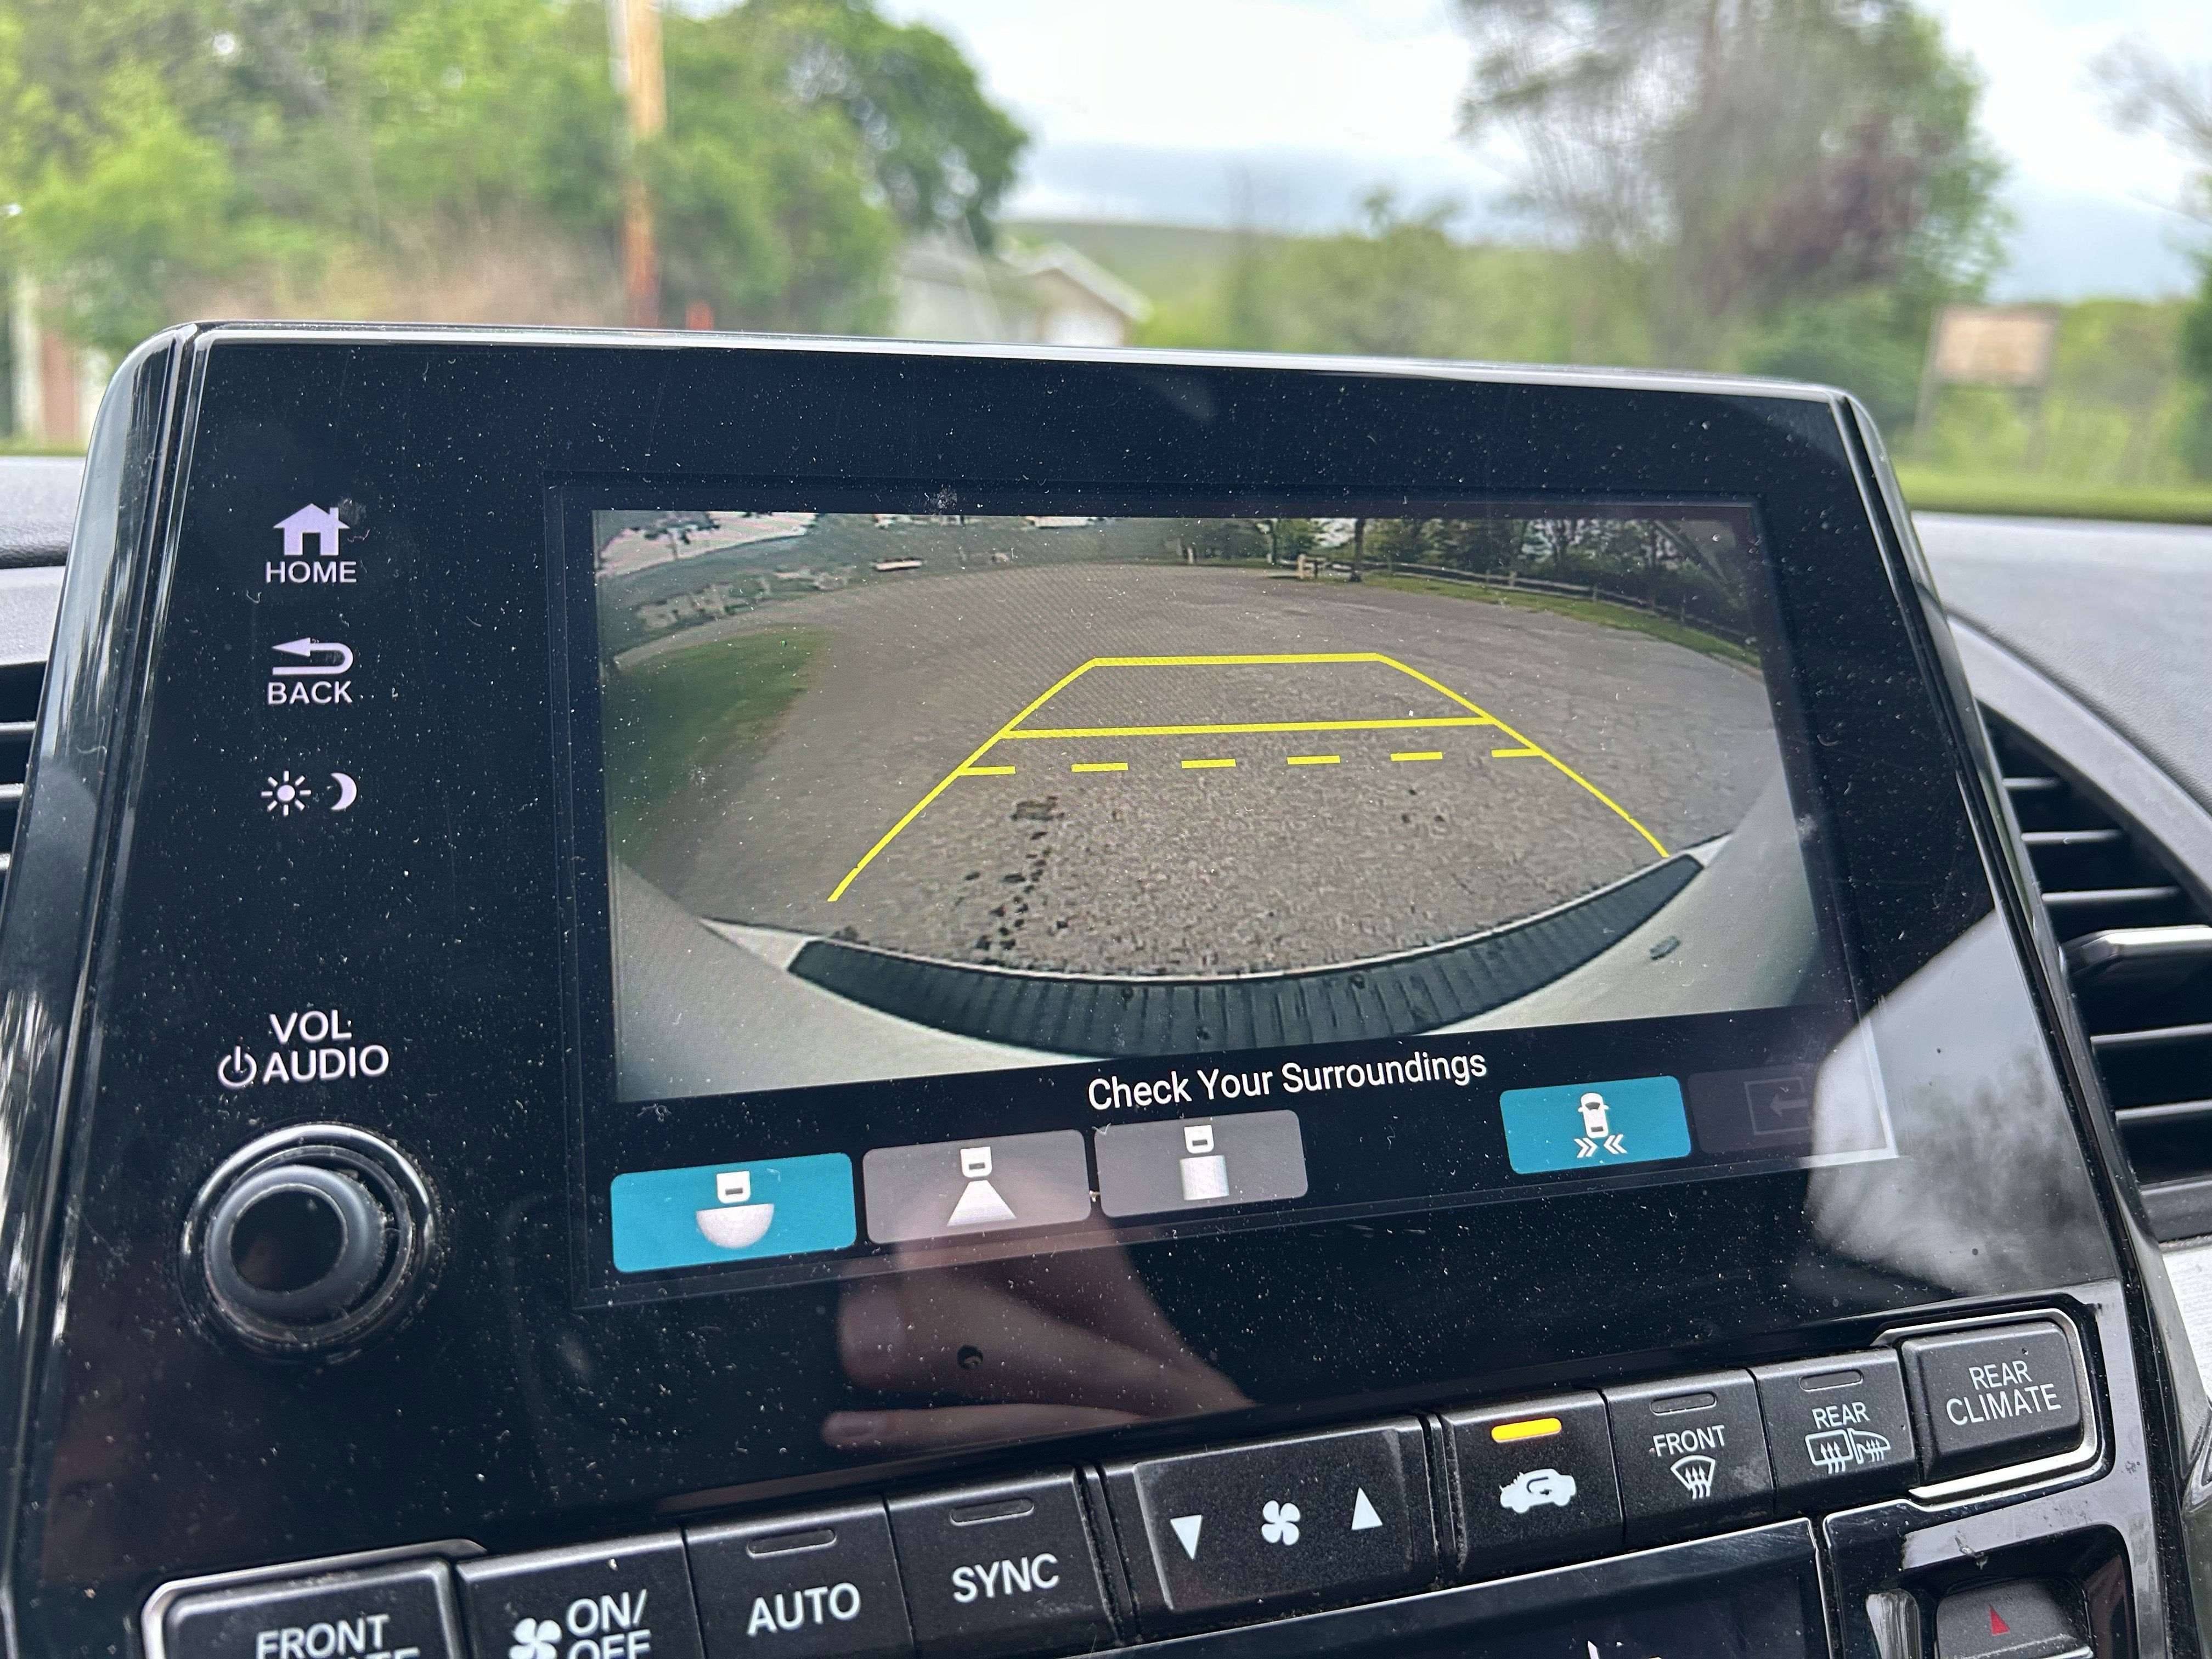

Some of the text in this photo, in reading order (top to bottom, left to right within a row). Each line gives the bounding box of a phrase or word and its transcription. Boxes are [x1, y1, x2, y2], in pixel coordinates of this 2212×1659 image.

[265, 561, 357, 583] HOME
[267, 681, 354, 705] BACK
[269, 1009, 352, 1045] VOL
[262, 1044, 390, 1085] AUDIO
[1088, 1051, 1488, 1110] Check Your Surroundings
[1968, 1359, 2032, 1391] REAR
[1812, 1401, 1870, 1430] REAR
[1946, 1384, 2062, 1426] CLIMATE
[1652, 1425, 1726, 1457] FRONT
[952, 1553, 1060, 1604] SYNC
[566, 1588, 647, 1637] ON/
[747, 1582, 861, 1637] AUTO
[256, 1613, 391, 1659] FRONT
[567, 1629, 652, 1659] OFF
